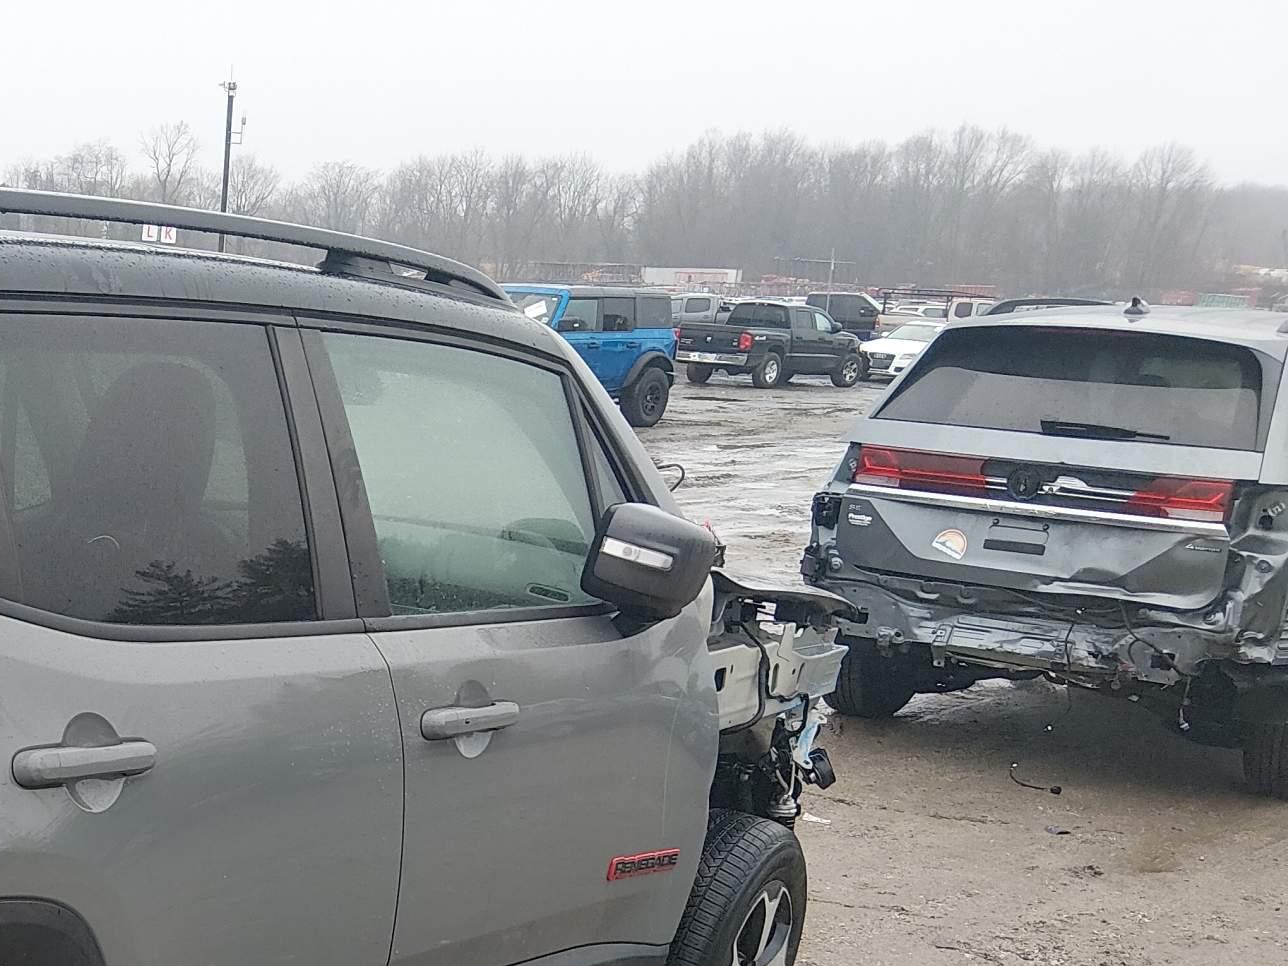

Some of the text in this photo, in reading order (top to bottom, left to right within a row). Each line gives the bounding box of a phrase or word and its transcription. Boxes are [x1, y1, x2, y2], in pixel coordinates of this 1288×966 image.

[147, 225, 154, 238] L
[164, 228, 173, 241] K
[614, 853, 679, 874] RENEGADE
